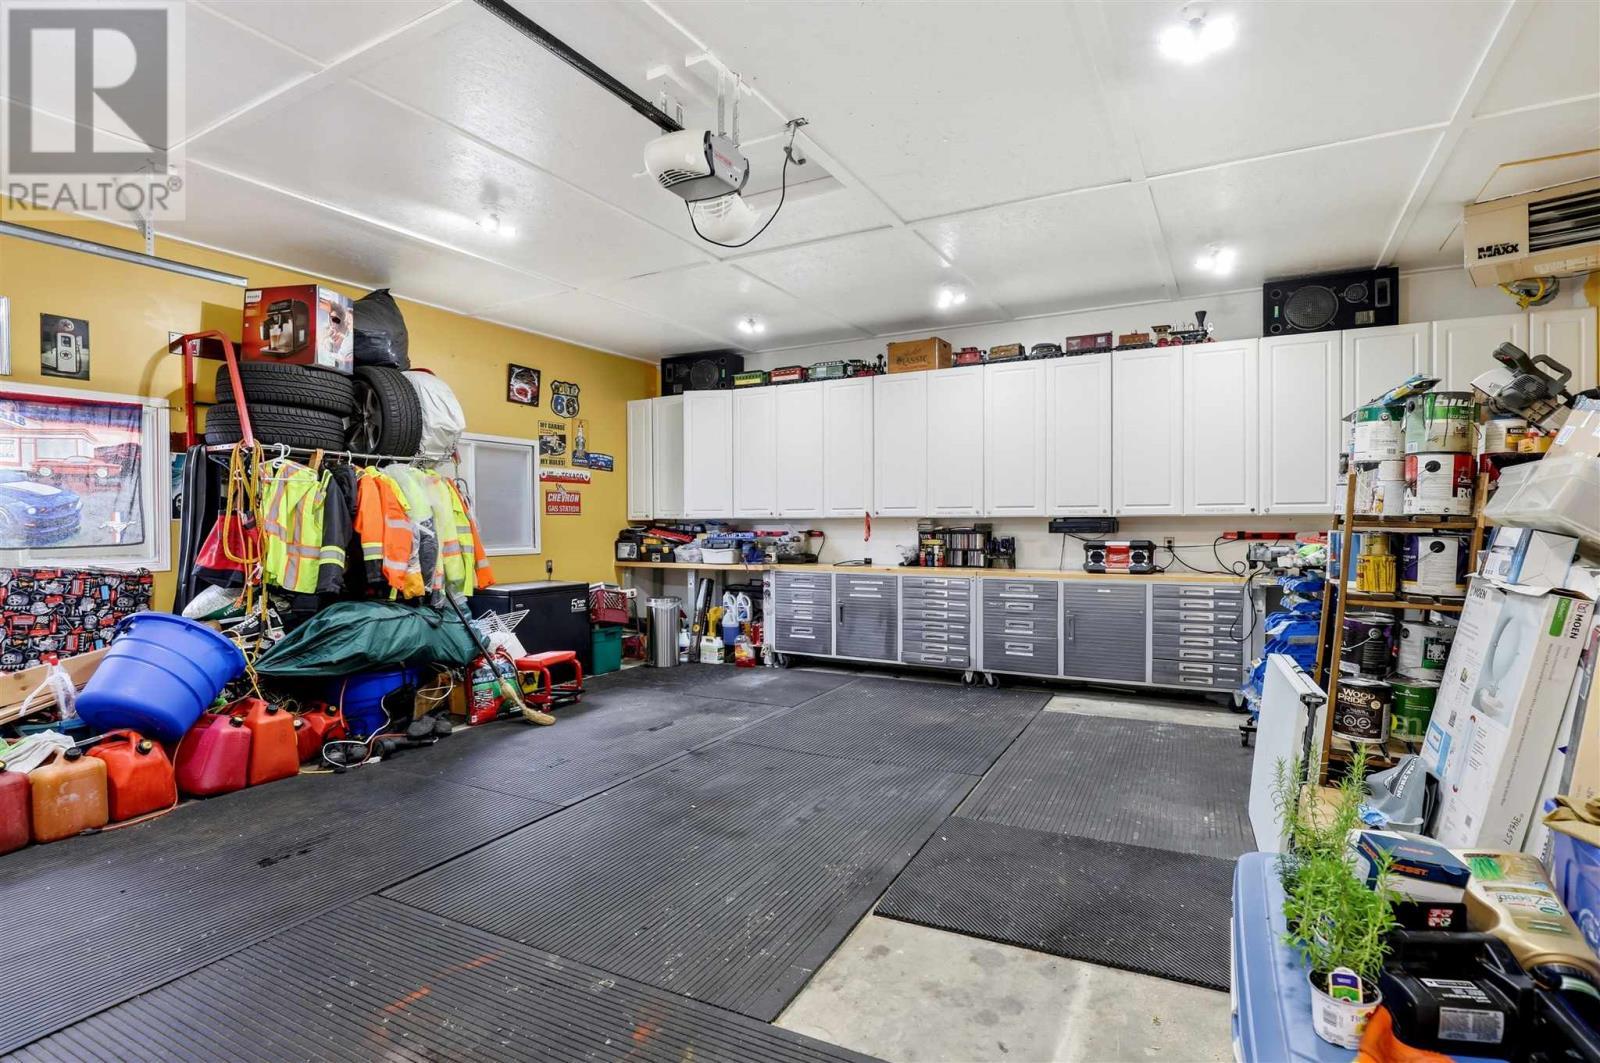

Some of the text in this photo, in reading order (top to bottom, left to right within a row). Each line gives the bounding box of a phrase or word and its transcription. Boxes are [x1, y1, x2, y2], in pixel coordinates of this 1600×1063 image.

[1477, 243, 1519, 259] MAXX
[547, 493, 579, 502] CHEVRON
[1569, 614, 1584, 639] MOEN
[1338, 692, 1367, 704] PRIDE
[1343, 688, 1376, 701] WOOD
